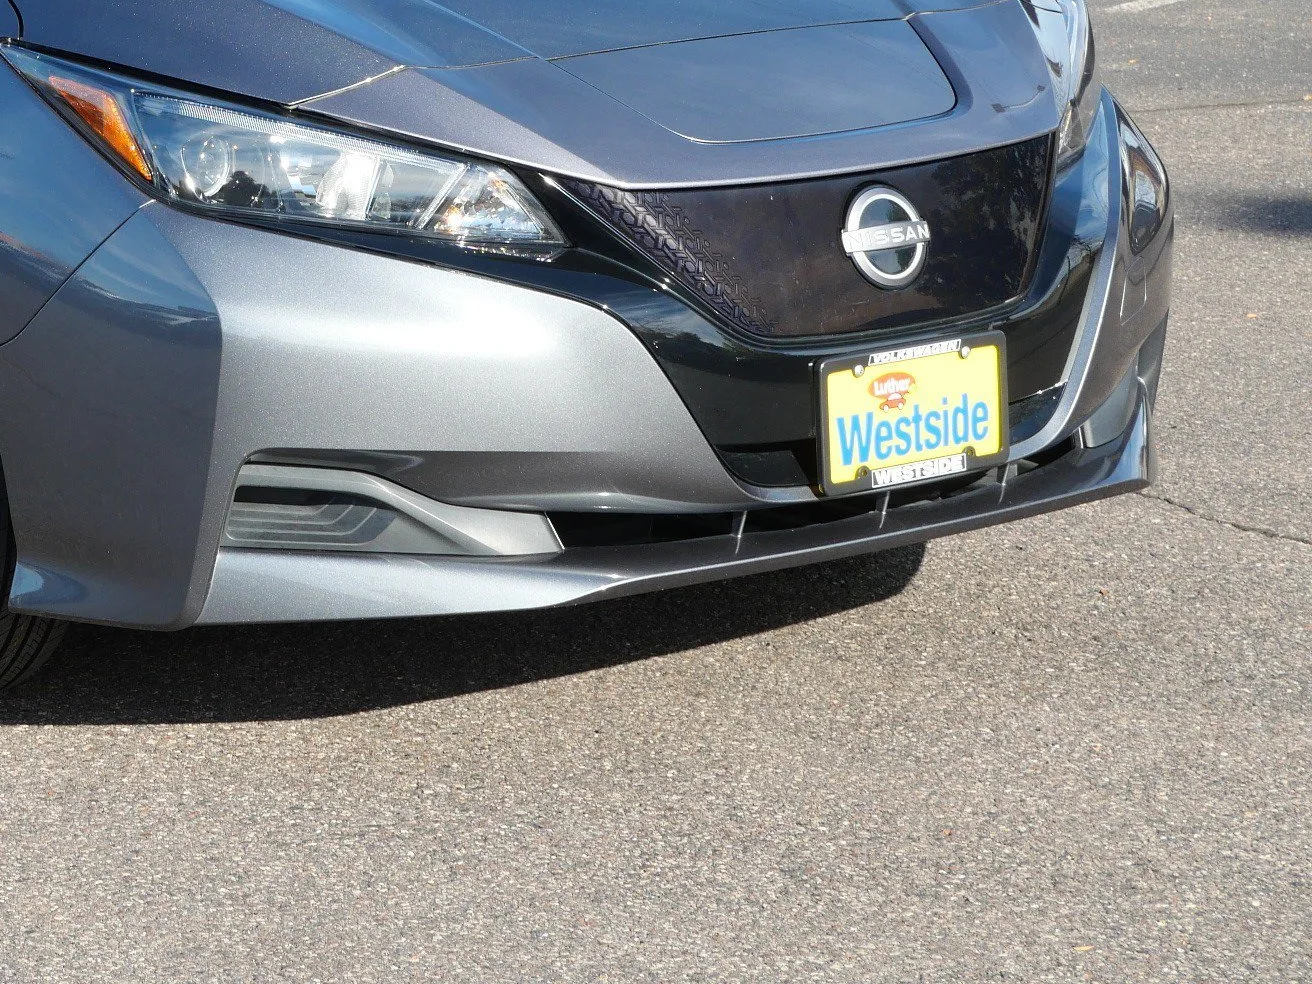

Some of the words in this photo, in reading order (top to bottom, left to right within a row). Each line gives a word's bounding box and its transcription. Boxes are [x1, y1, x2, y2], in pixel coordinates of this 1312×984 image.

[847, 223, 931, 250] NISSAN
[873, 377, 911, 396] Luther
[836, 393, 990, 466] Westside
[873, 456, 966, 487] WESTSIDE
